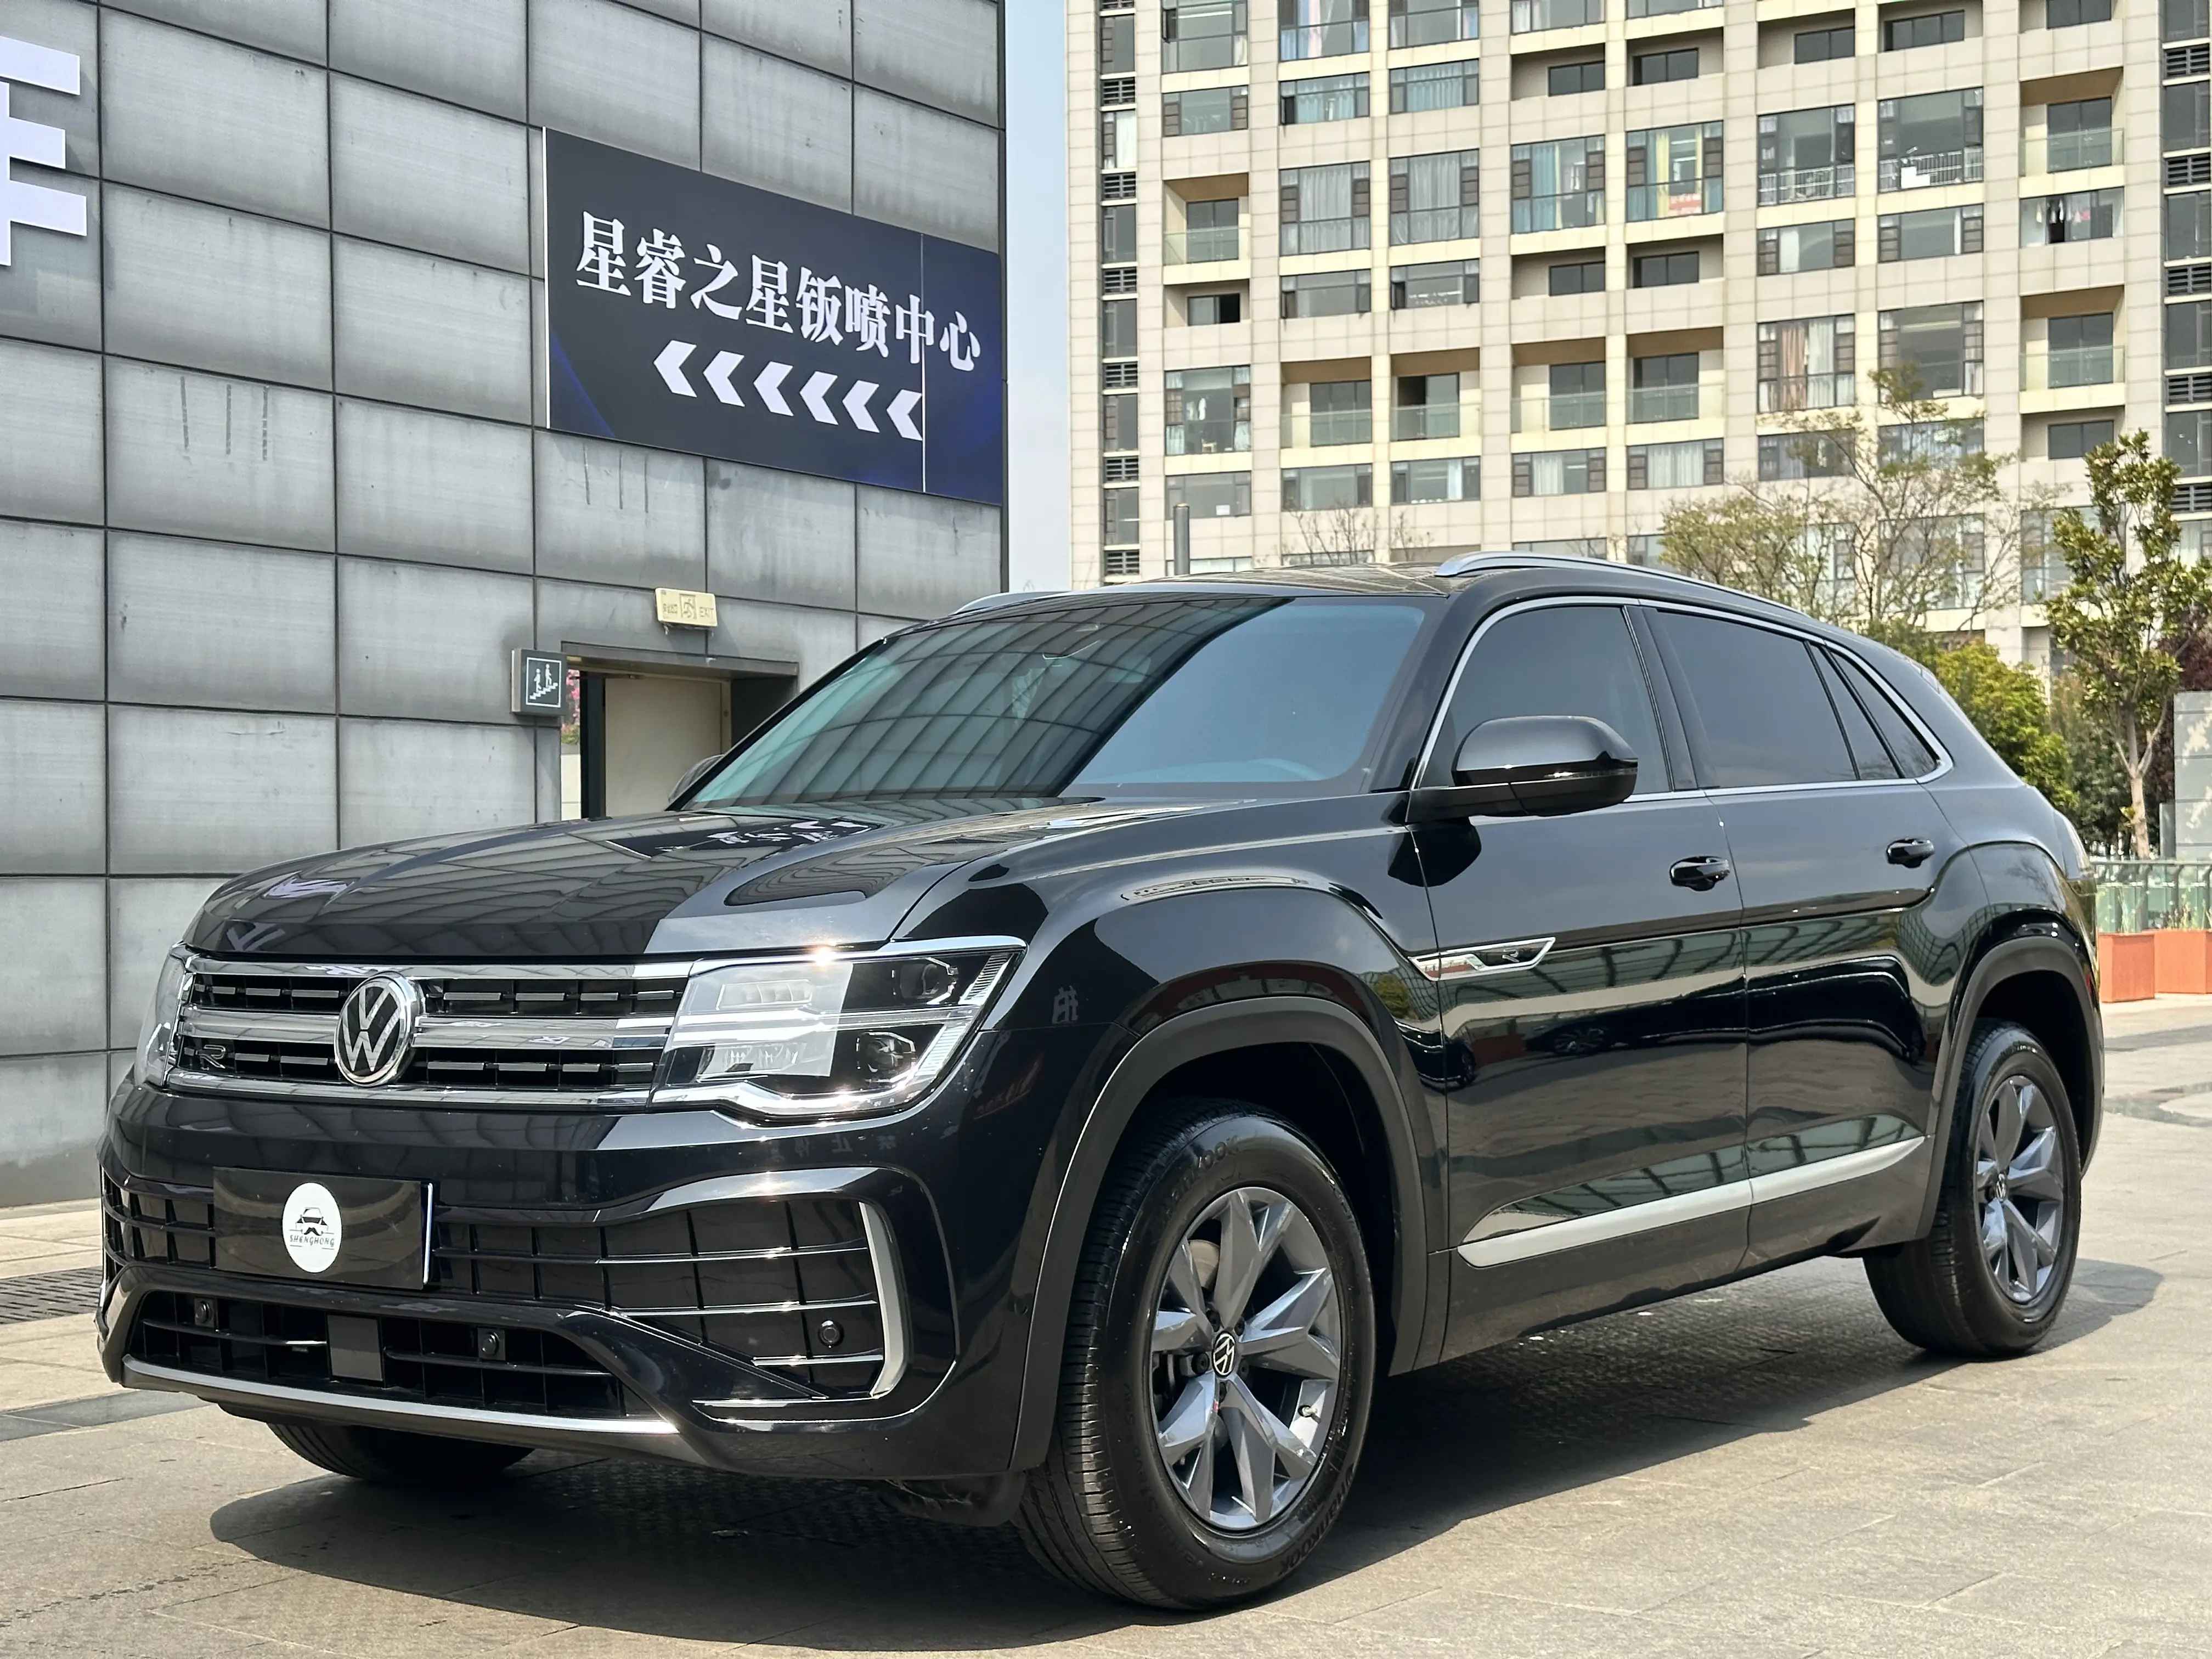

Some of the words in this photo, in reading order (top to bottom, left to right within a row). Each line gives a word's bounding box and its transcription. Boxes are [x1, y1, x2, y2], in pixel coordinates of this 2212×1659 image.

[576, 211, 981, 371] 星睿之星钣喷中心
[290, 1234, 335, 1248] SHENGHONG
